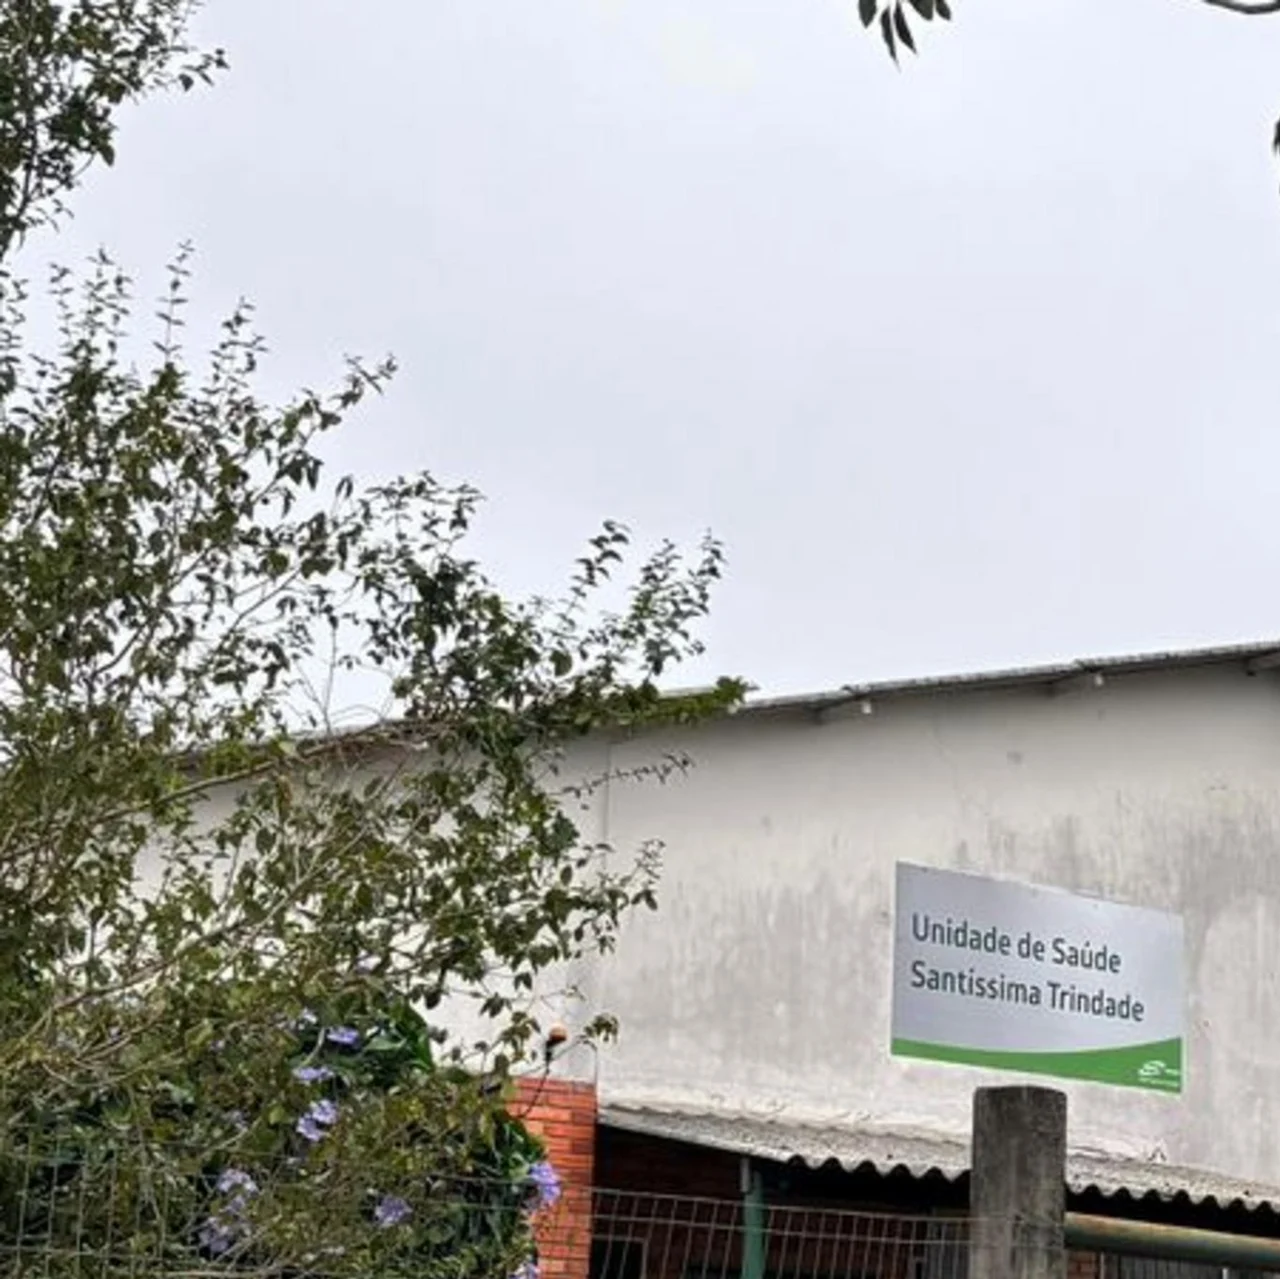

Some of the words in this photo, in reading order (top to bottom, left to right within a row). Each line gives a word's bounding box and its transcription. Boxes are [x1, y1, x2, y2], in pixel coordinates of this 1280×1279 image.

[912, 913, 1011, 956] Unidade
[1018, 933, 1045, 961] de
[1053, 938, 1121, 973] Saúde
[1047, 981, 1144, 1022] Trindade
